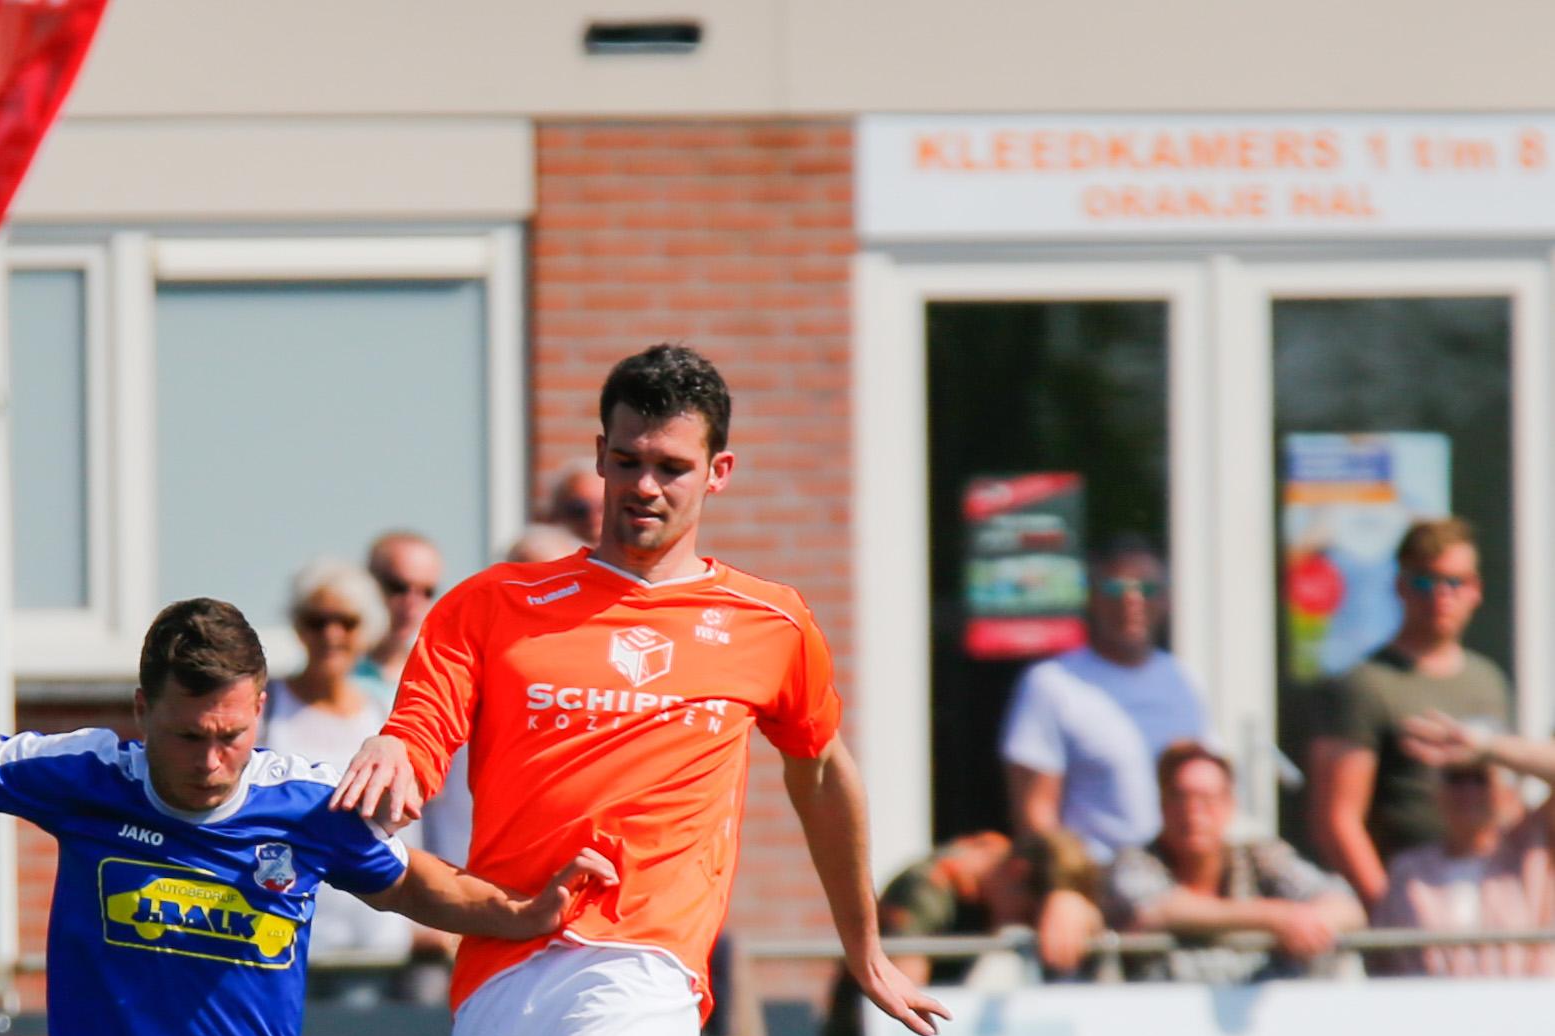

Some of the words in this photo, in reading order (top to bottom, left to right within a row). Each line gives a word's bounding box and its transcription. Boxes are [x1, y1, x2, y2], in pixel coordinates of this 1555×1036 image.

[913, 129, 1343, 172] KLEEDKAMERS
[1080, 183, 1271, 219] ORANJE
[526, 582, 581, 606] hummel
[527, 683, 728, 716] SCHIPPR
[528, 711, 722, 735] KOZINEN
[118, 824, 164, 847] JAKO
[155, 882, 239, 903] AUTOBEDRIJF
